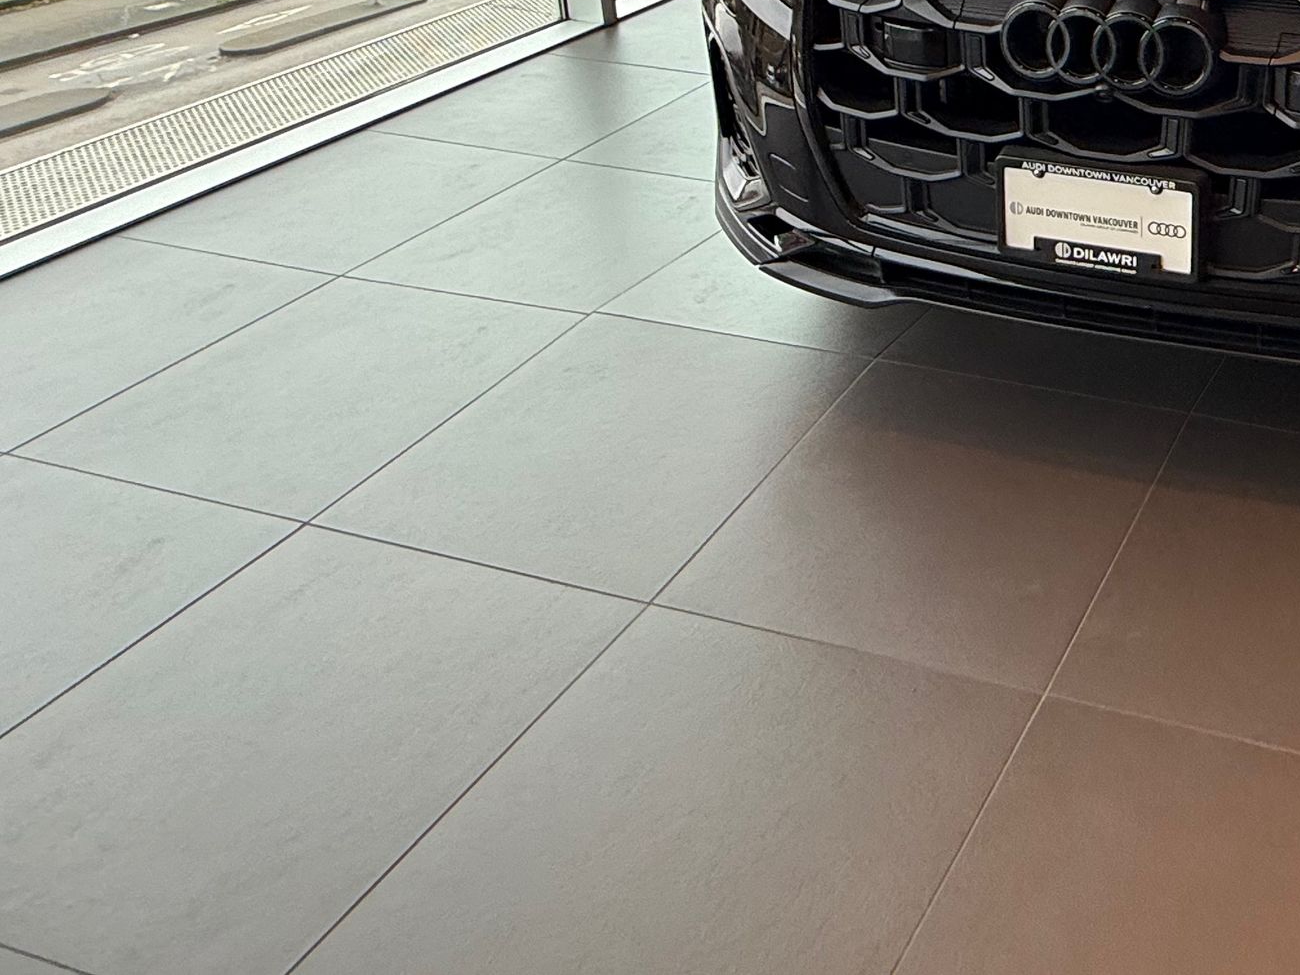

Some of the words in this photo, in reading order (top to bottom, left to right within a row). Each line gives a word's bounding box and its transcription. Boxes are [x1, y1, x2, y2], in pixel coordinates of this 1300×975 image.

[1021, 161, 1046, 172] AUDI
[1047, 164, 1111, 181] DOWNTOWN
[1112, 173, 1176, 190] VANCOUVER
[1026, 205, 1044, 216] AUDI
[1045, 209, 1091, 223] DOWNTOWN
[1093, 215, 1138, 230] VANCOUVER
[1073, 247, 1137, 267] DILAWRI
